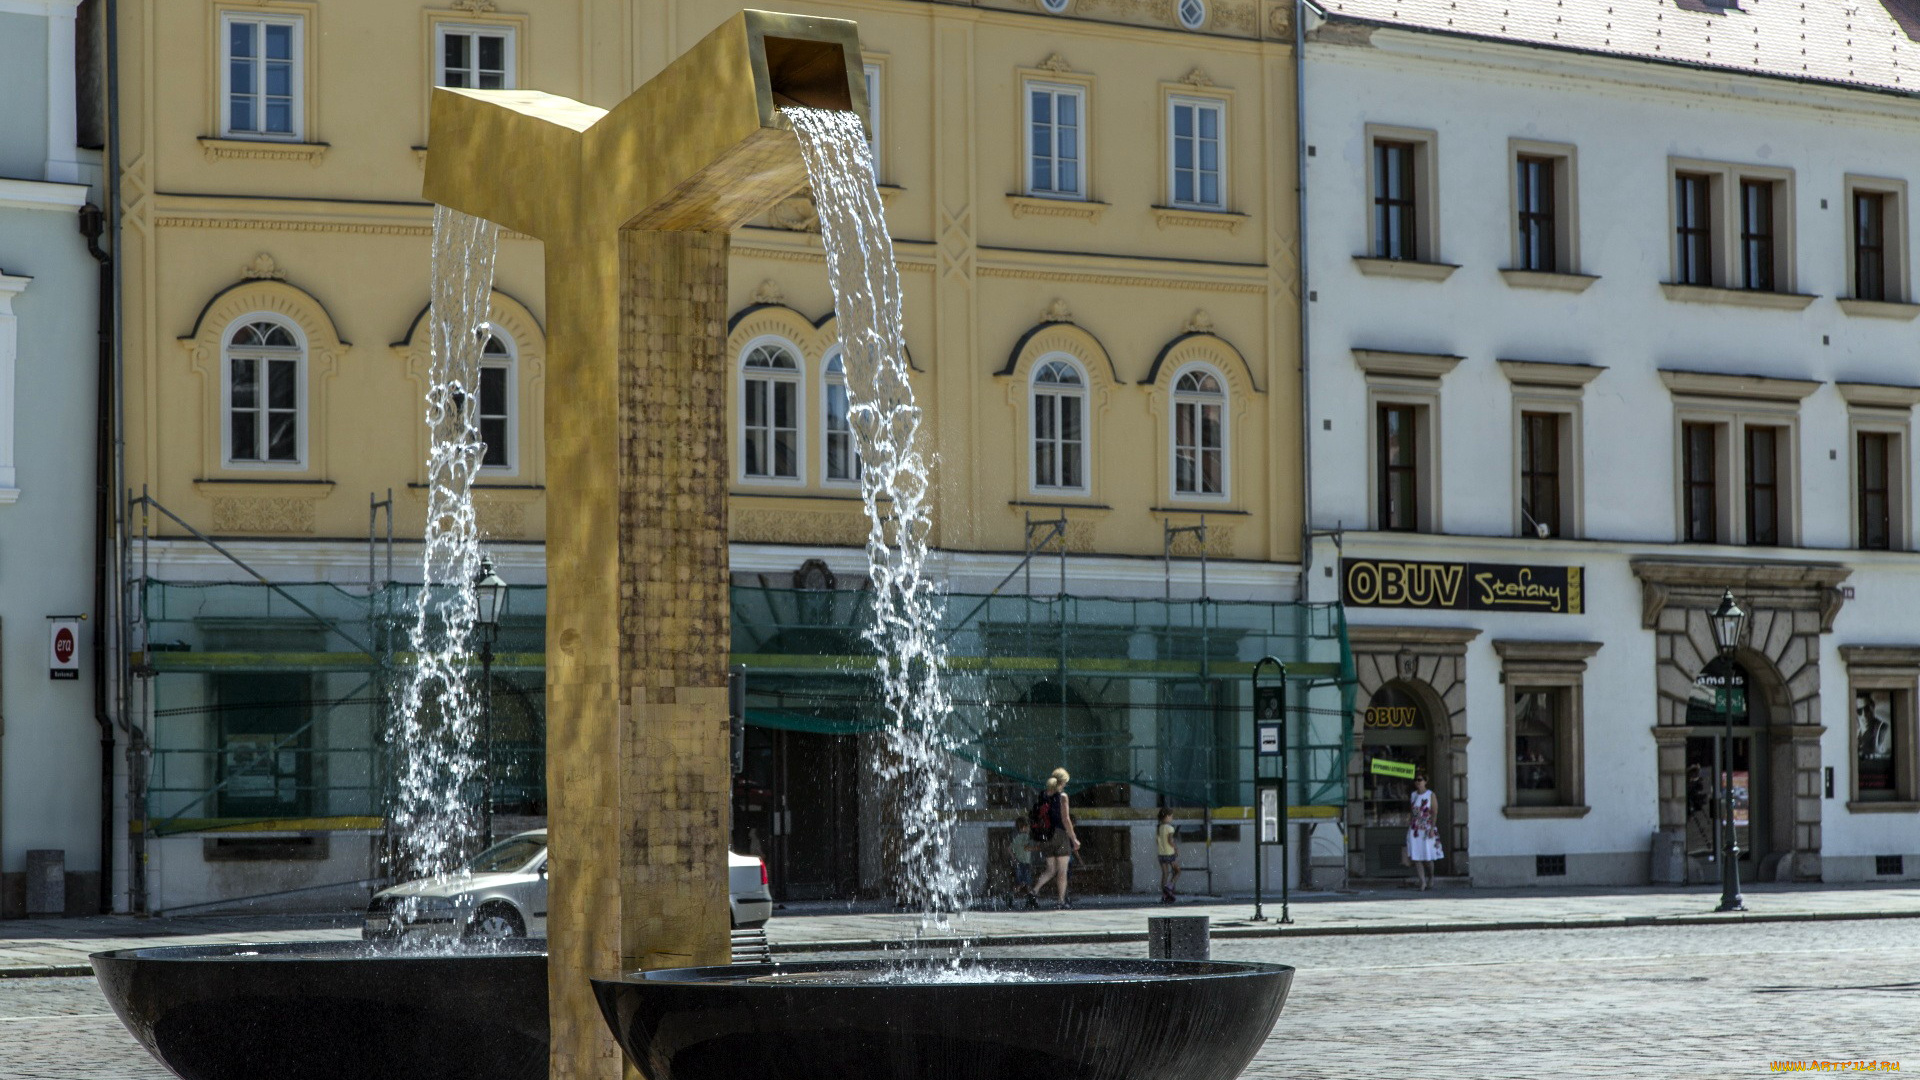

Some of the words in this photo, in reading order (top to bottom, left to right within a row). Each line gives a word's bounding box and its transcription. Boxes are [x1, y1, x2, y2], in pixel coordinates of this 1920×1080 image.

[1349, 561, 1464, 606] OBUV
[1475, 568, 1561, 612] Stefany
[57, 639, 71, 651] era
[1364, 706, 1416, 727] OBUV
